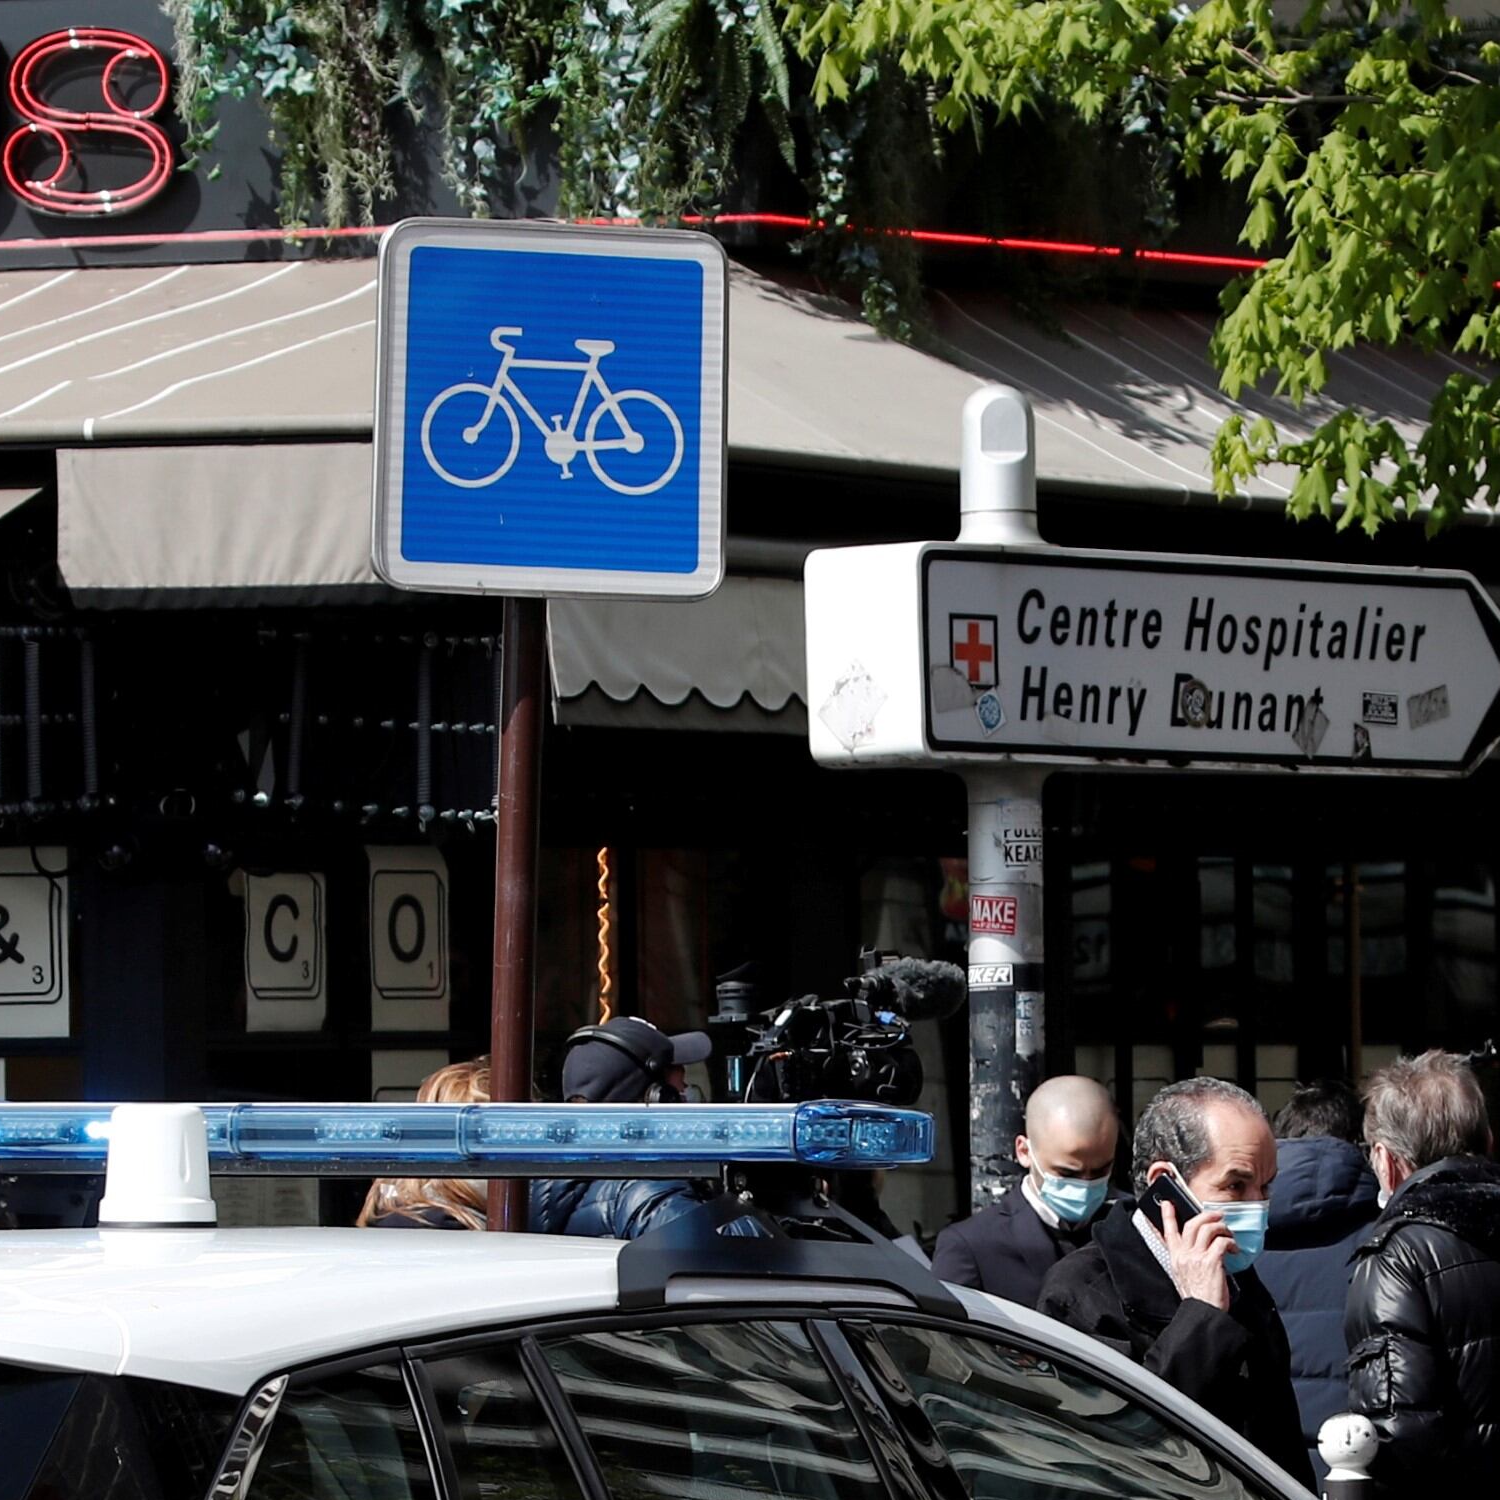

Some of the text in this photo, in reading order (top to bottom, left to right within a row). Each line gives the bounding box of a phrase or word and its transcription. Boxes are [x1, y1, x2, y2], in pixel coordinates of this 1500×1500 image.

[1017, 588, 1426, 671] Centre Hospitalier
[1020, 666, 1147, 736] Henry
[972, 899, 1015, 924] MAKE
